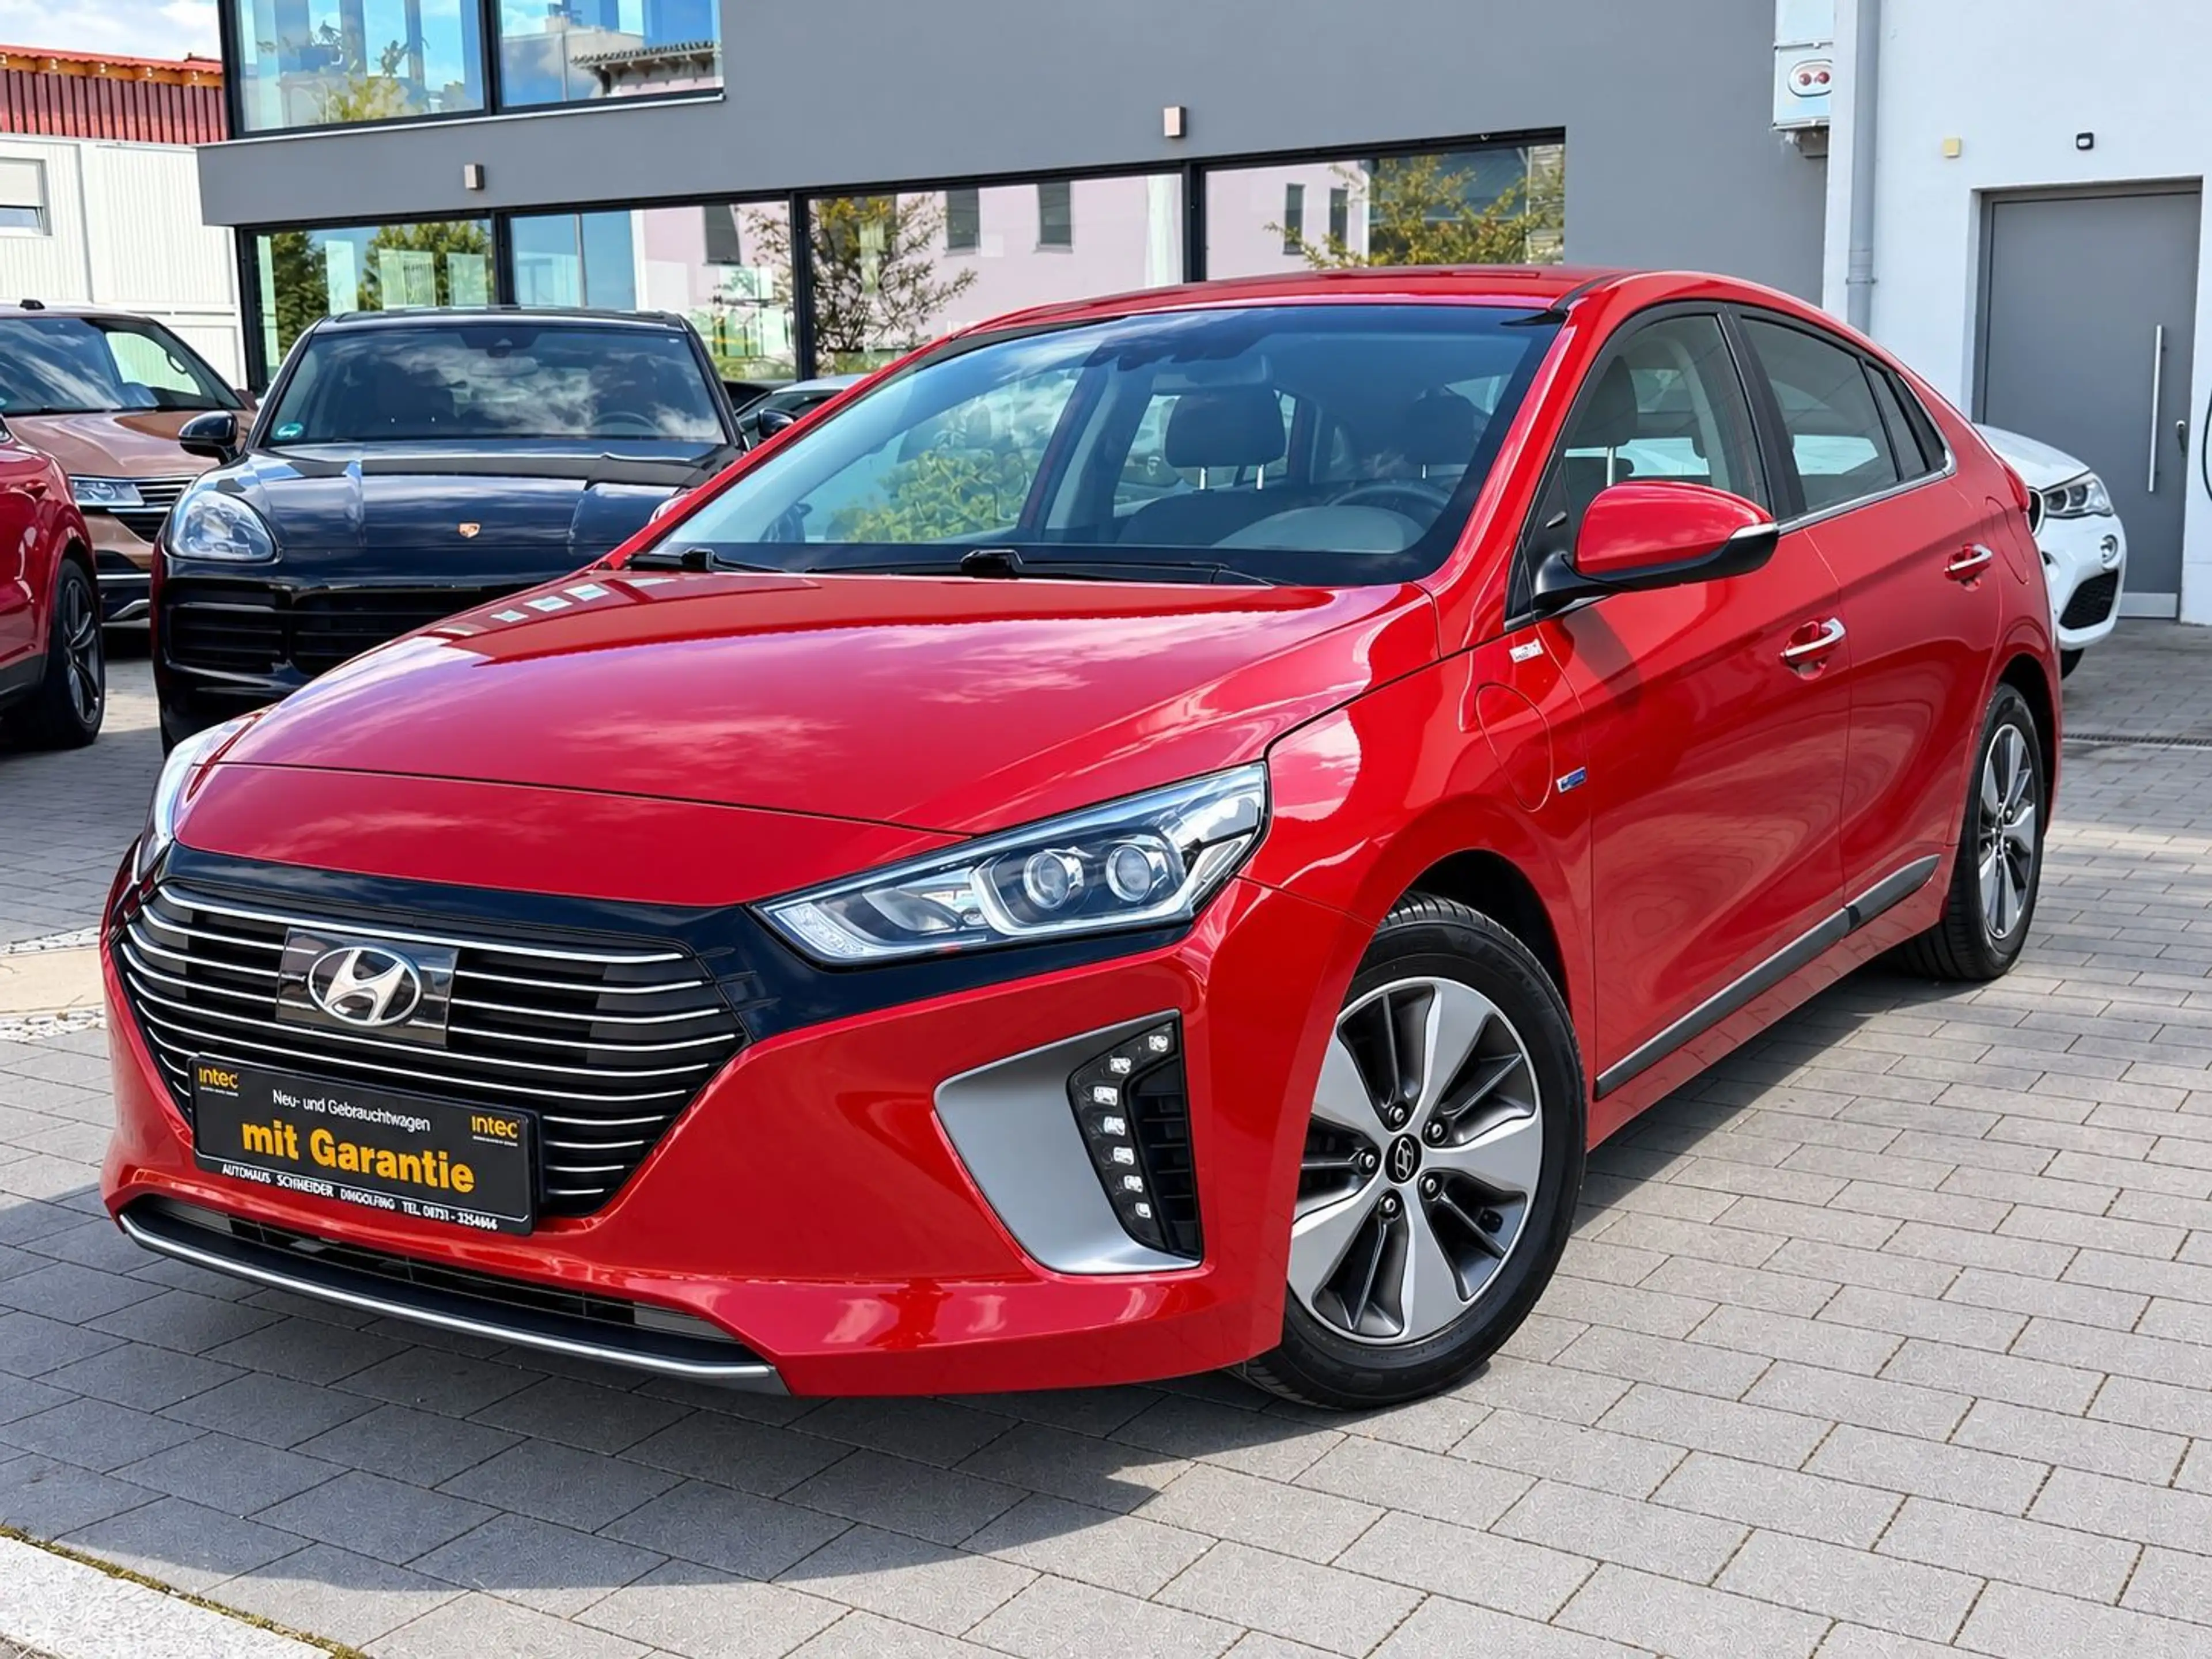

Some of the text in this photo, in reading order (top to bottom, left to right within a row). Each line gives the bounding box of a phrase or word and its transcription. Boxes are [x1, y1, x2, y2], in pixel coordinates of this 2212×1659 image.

[198, 1067, 239, 1089] intec
[272, 1089, 431, 1133] Neu- und Gebrauchtwagen
[471, 1115, 519, 1139] intec
[241, 1119, 475, 1193] mit Garantie
[221, 1164, 271, 1184] AUTOHAUS
[276, 1174, 334, 1198] SCHNEIDER
[340, 1187, 396, 1210] DINGOLFING
